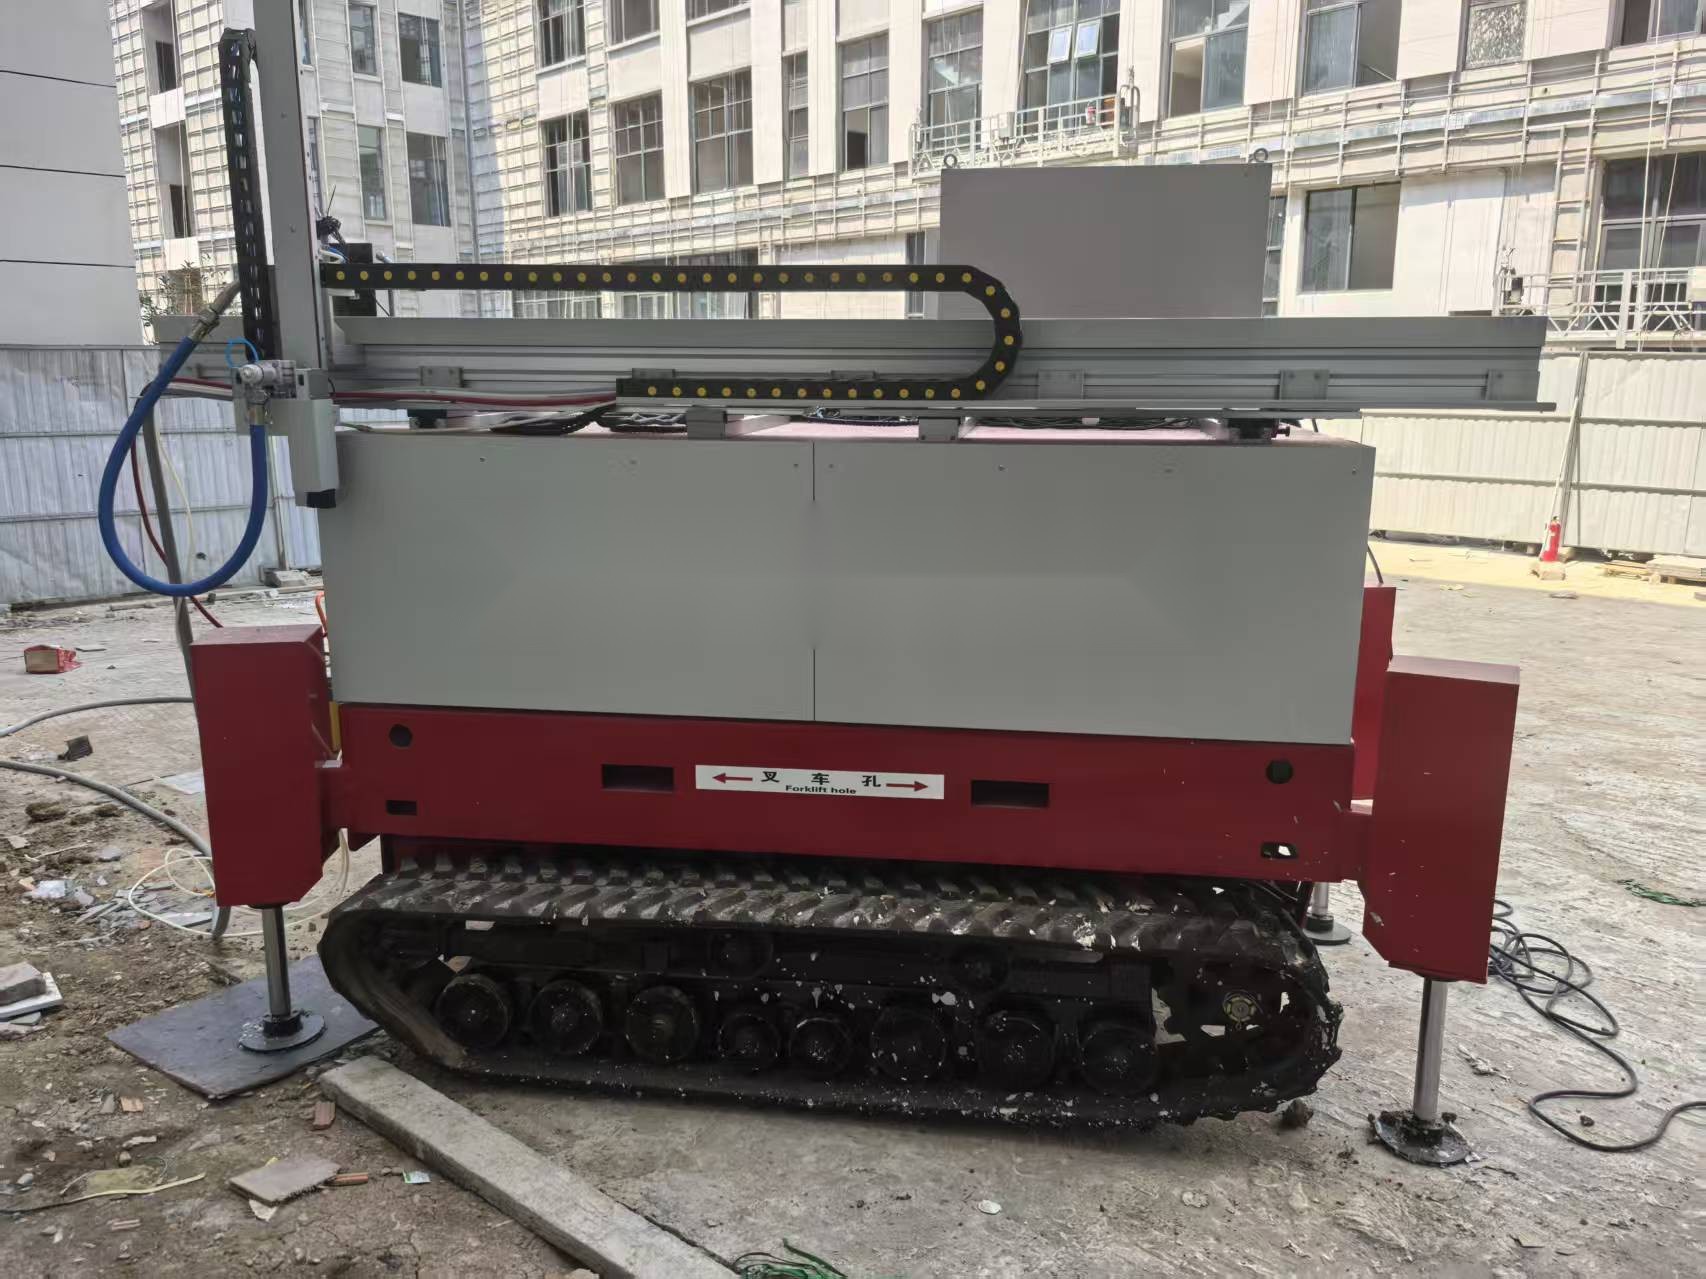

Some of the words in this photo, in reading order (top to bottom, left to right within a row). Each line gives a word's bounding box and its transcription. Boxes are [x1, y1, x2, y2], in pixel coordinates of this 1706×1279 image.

[761, 771, 881, 787] 叉车孔
[785, 785, 827, 793] Forklift
[831, 786, 857, 795] hole
